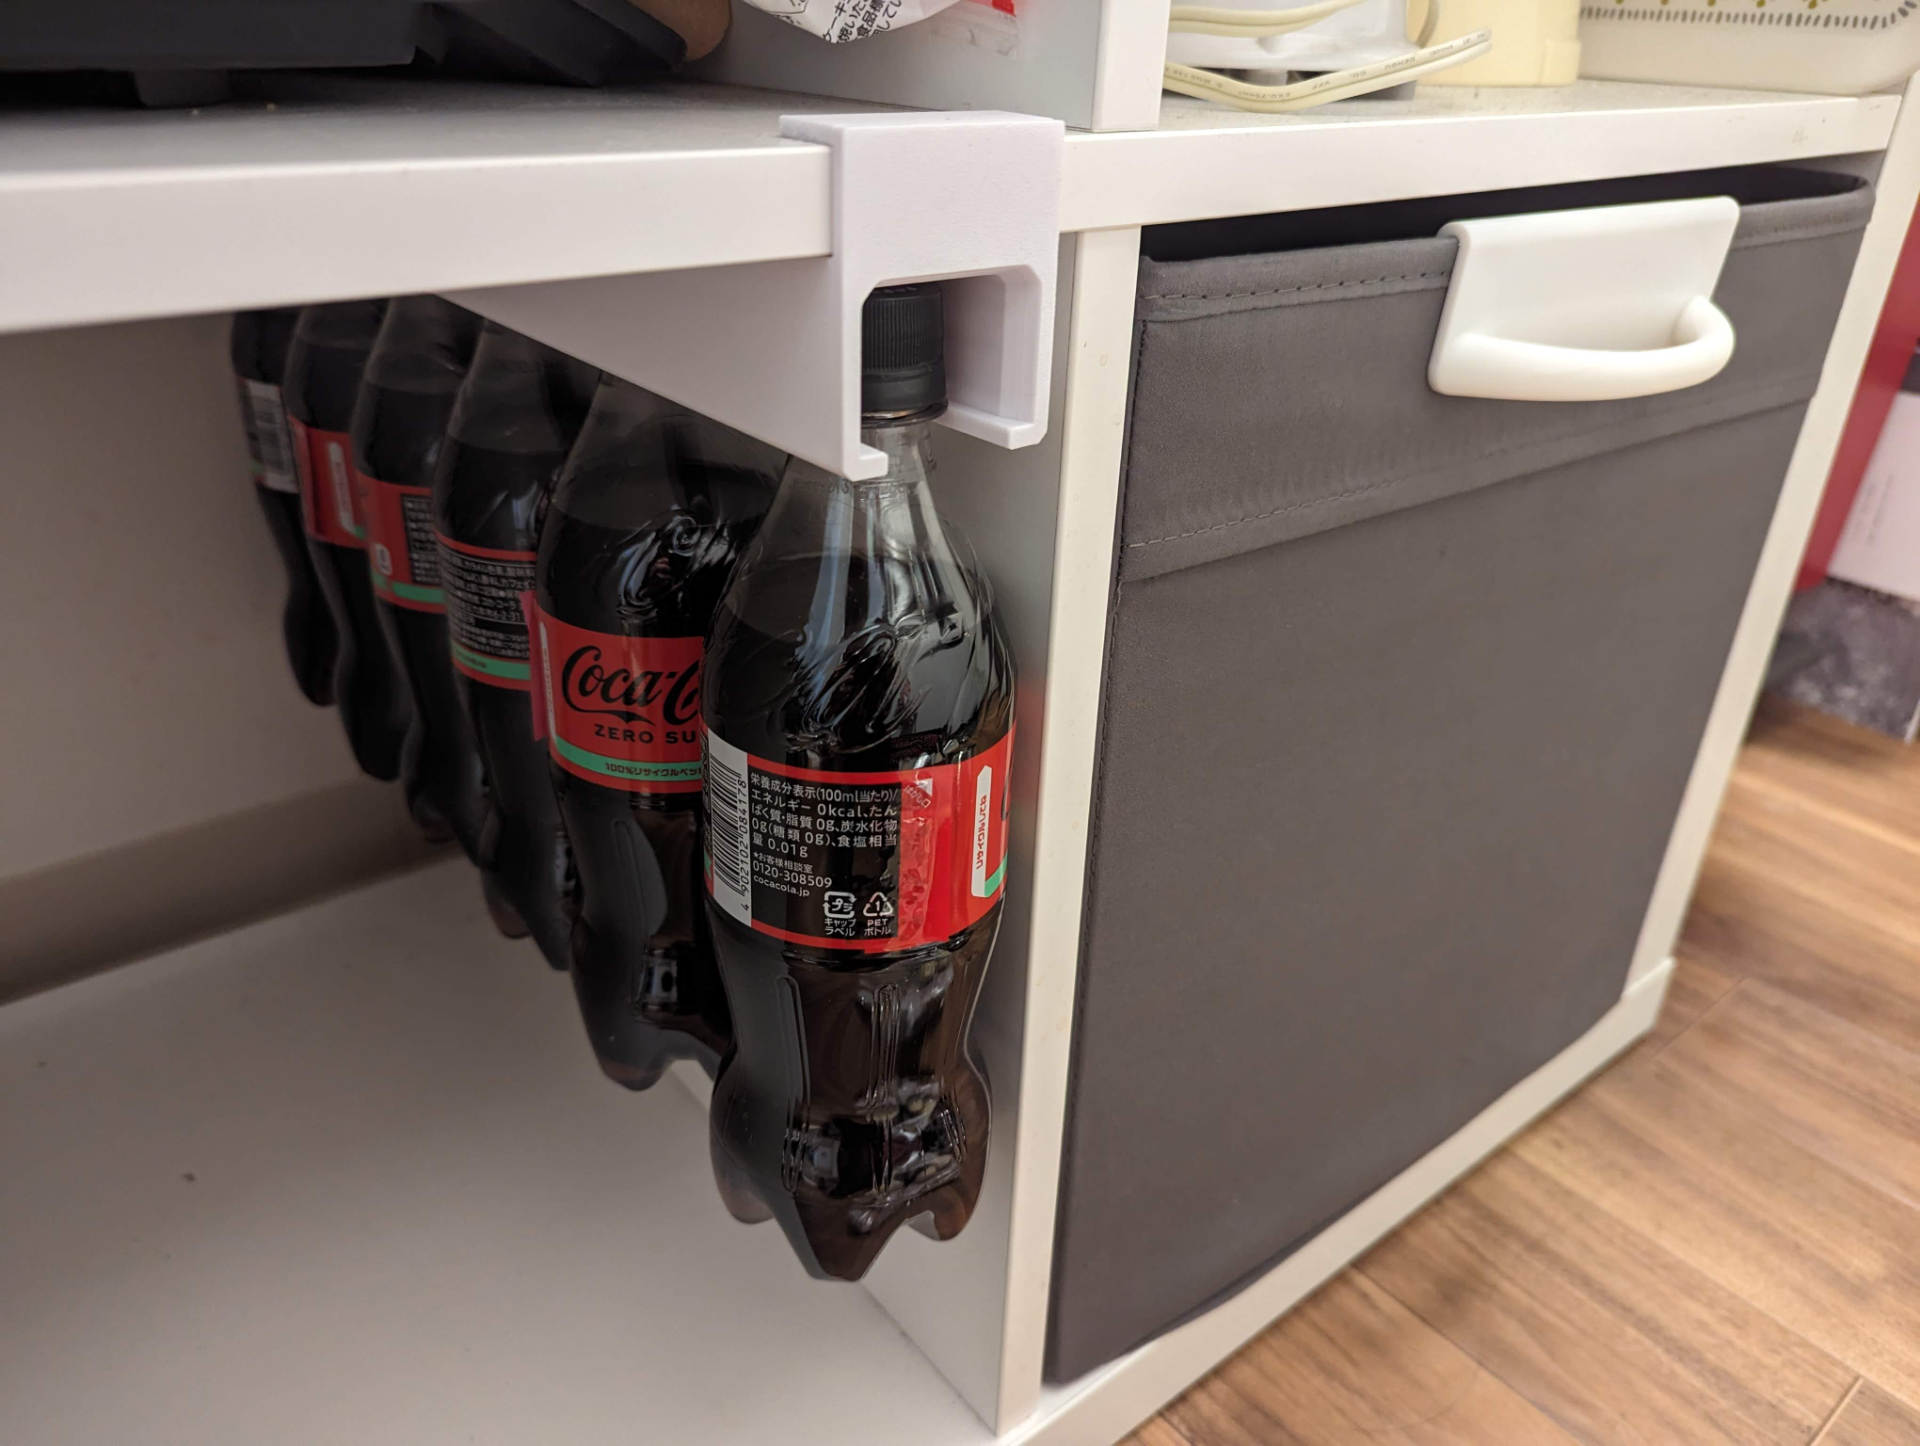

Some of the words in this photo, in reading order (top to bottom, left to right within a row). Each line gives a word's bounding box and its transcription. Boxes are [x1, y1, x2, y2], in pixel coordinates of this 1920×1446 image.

[594, 723, 654, 744] ZERO
[752, 831, 764, 847] 量
[768, 838, 808, 858] 0.01g
[752, 860, 833, 888] 0120-308509
[753, 875, 810, 897] cocacola.jp
[824, 917, 857, 928] キャップ
[867, 919, 889, 927] PET
[824, 926, 856, 937] ラベル
[864, 926, 892, 937] ボトル
